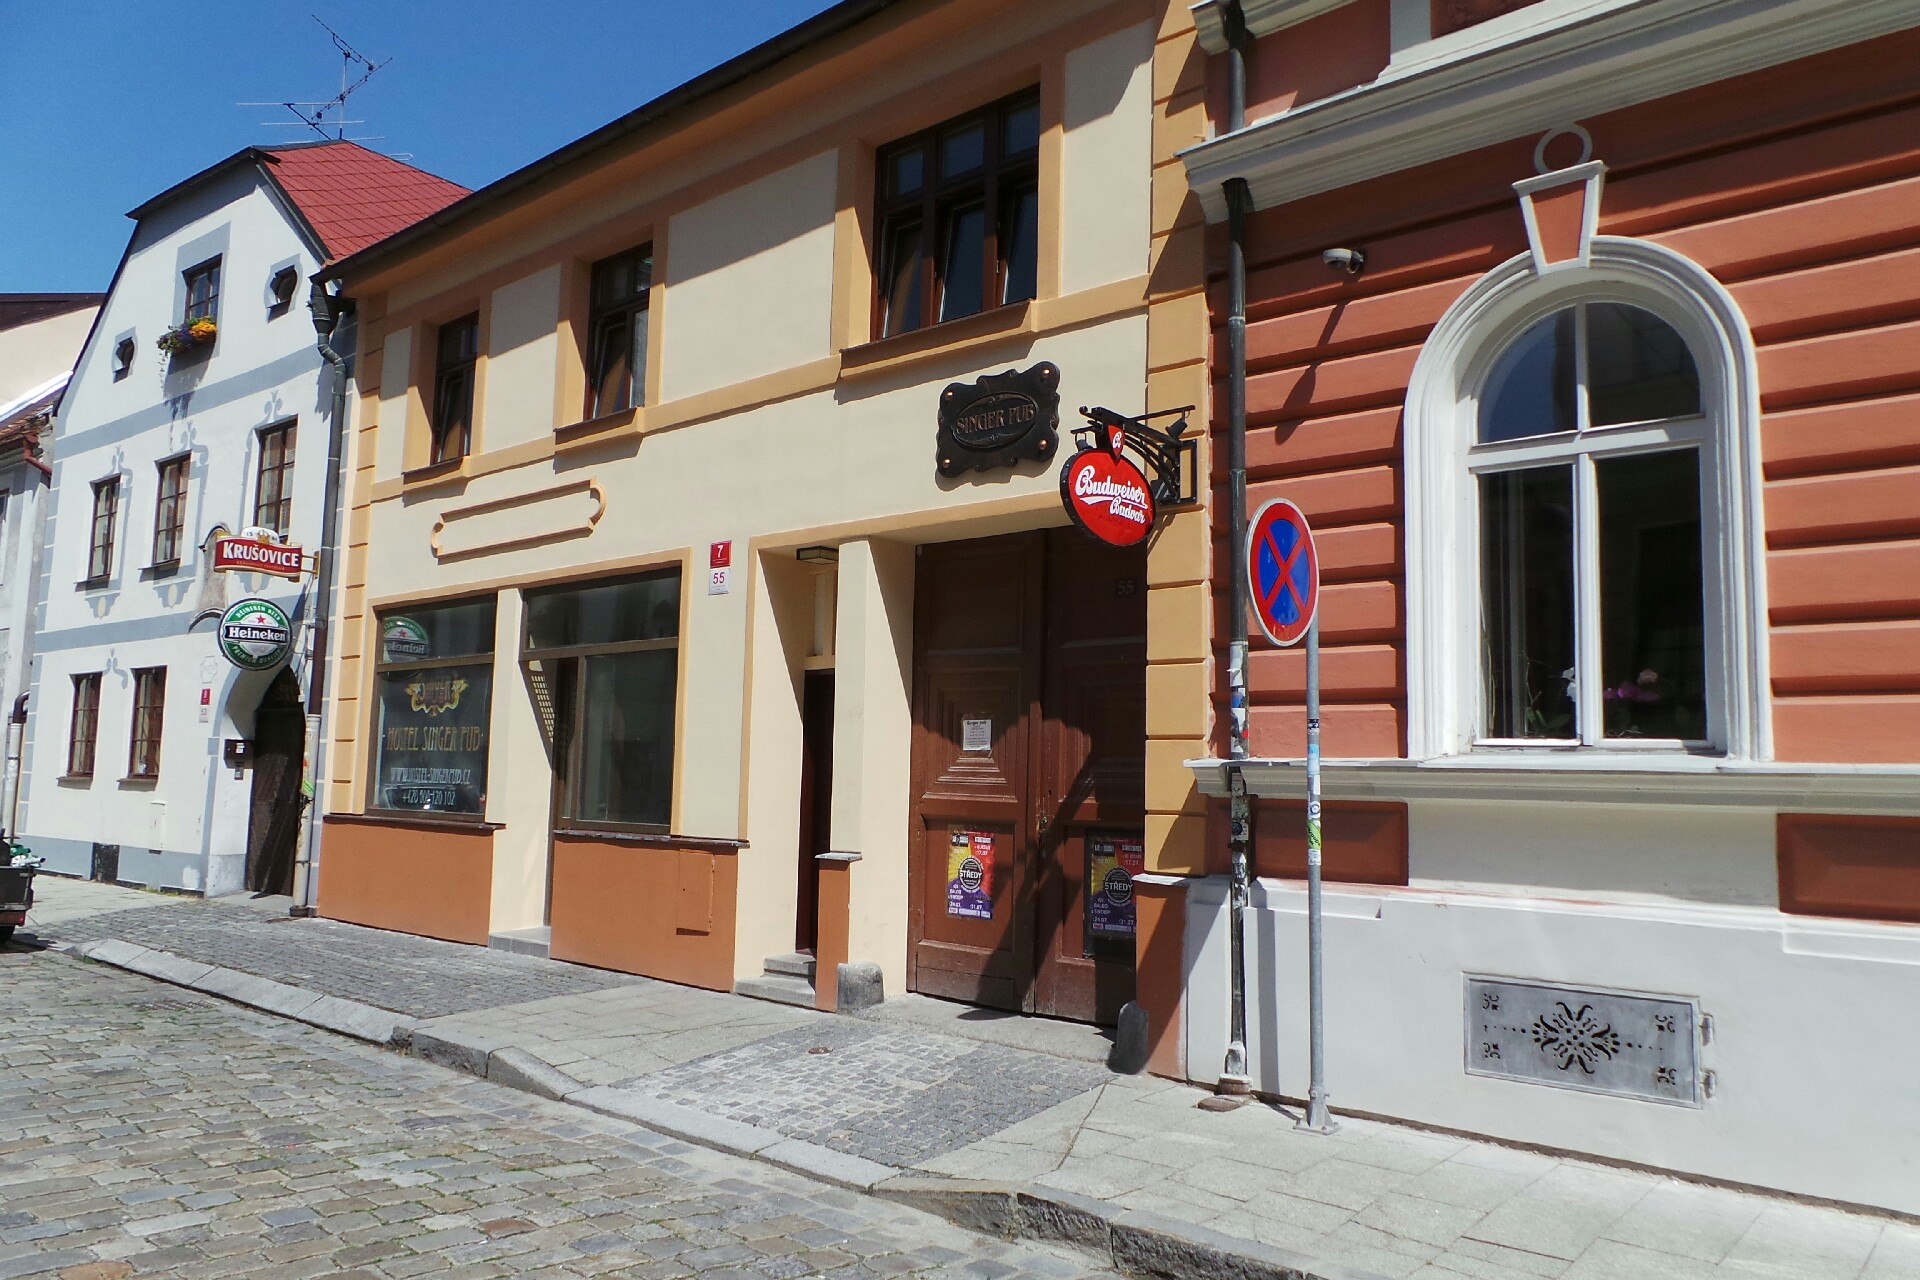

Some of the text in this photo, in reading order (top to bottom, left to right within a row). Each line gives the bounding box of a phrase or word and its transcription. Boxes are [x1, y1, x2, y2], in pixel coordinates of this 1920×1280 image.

[956, 403, 1035, 434] SINGER PUB
[1075, 465, 1147, 508] Budweiser
[1109, 496, 1145, 524] Budvar
[222, 541, 300, 567] KRUŠOVICE
[717, 544, 724, 558] 7
[712, 571, 725, 585] 55
[228, 626, 286, 642] Heineken
[421, 726, 457, 752] SINGER
[459, 726, 480, 752] PUB
[959, 868, 983, 880] STŘEDY
[1104, 881, 1133, 892] STŘEDY
